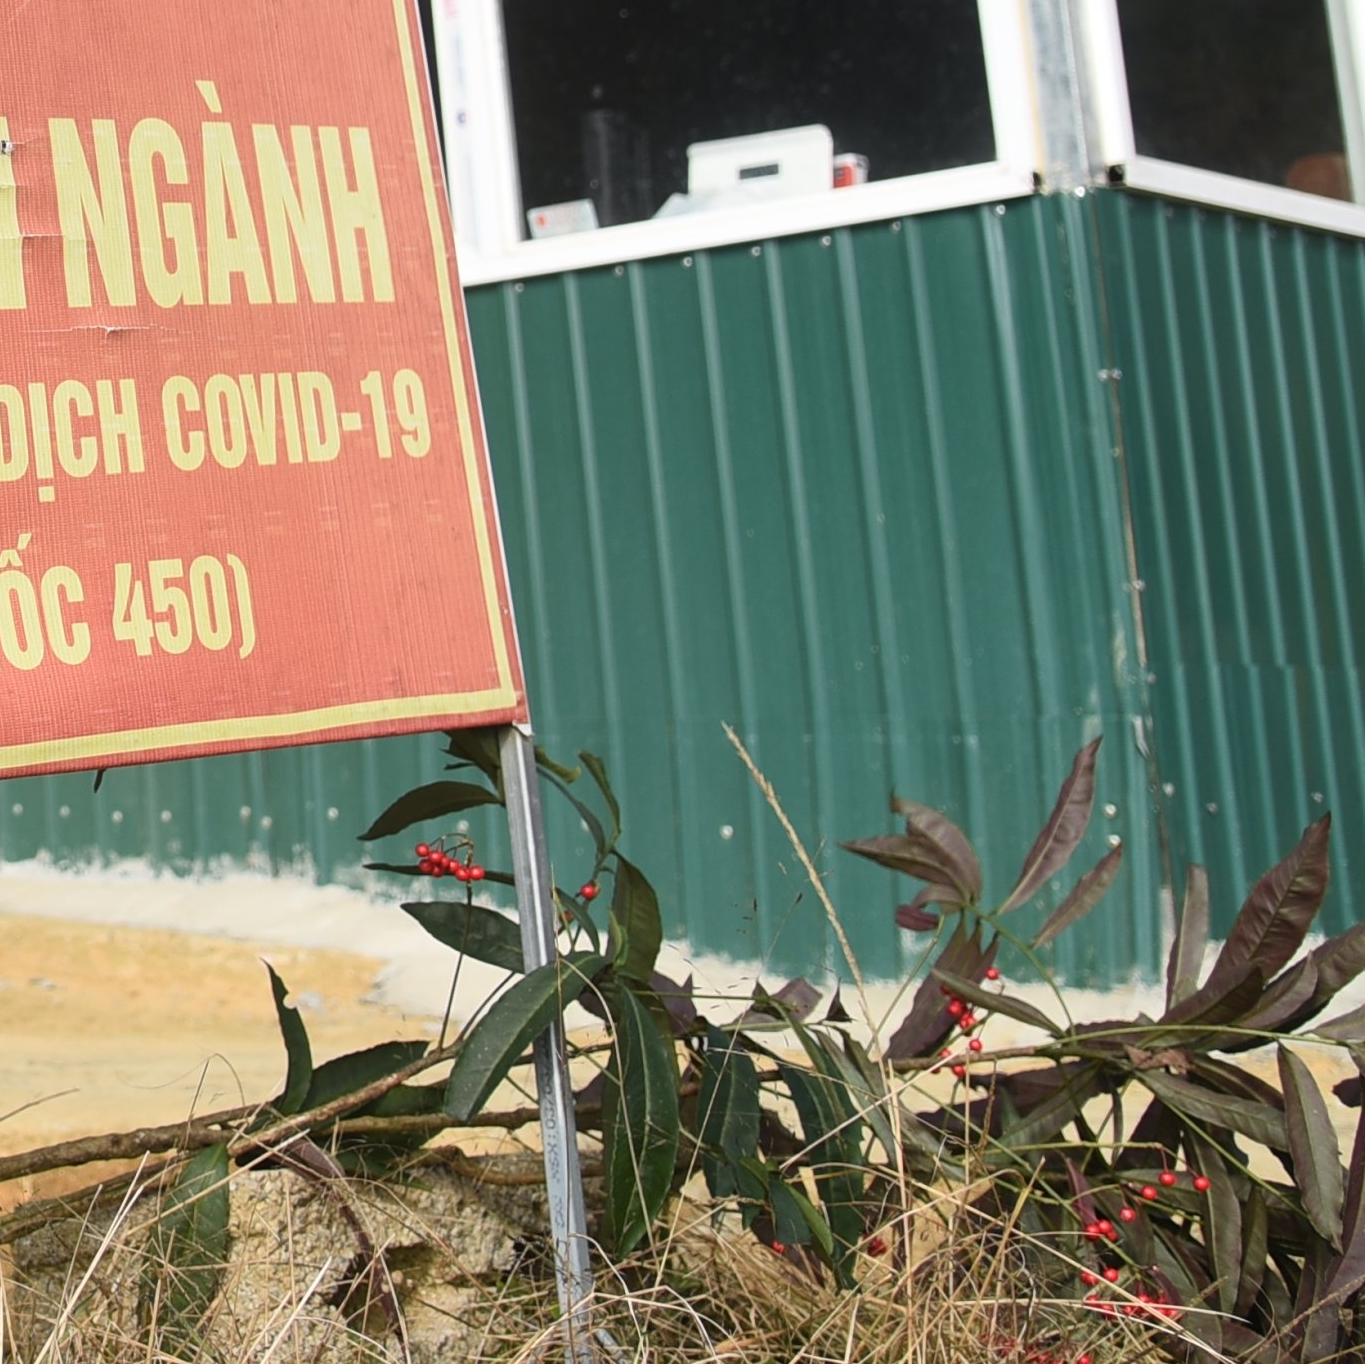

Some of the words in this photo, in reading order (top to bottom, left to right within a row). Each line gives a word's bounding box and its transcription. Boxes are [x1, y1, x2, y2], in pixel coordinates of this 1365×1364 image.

[49, 81, 394, 308] NGÀNH
[163, 369, 430, 470] COVID-19
[114, 555, 255, 657] 450)
